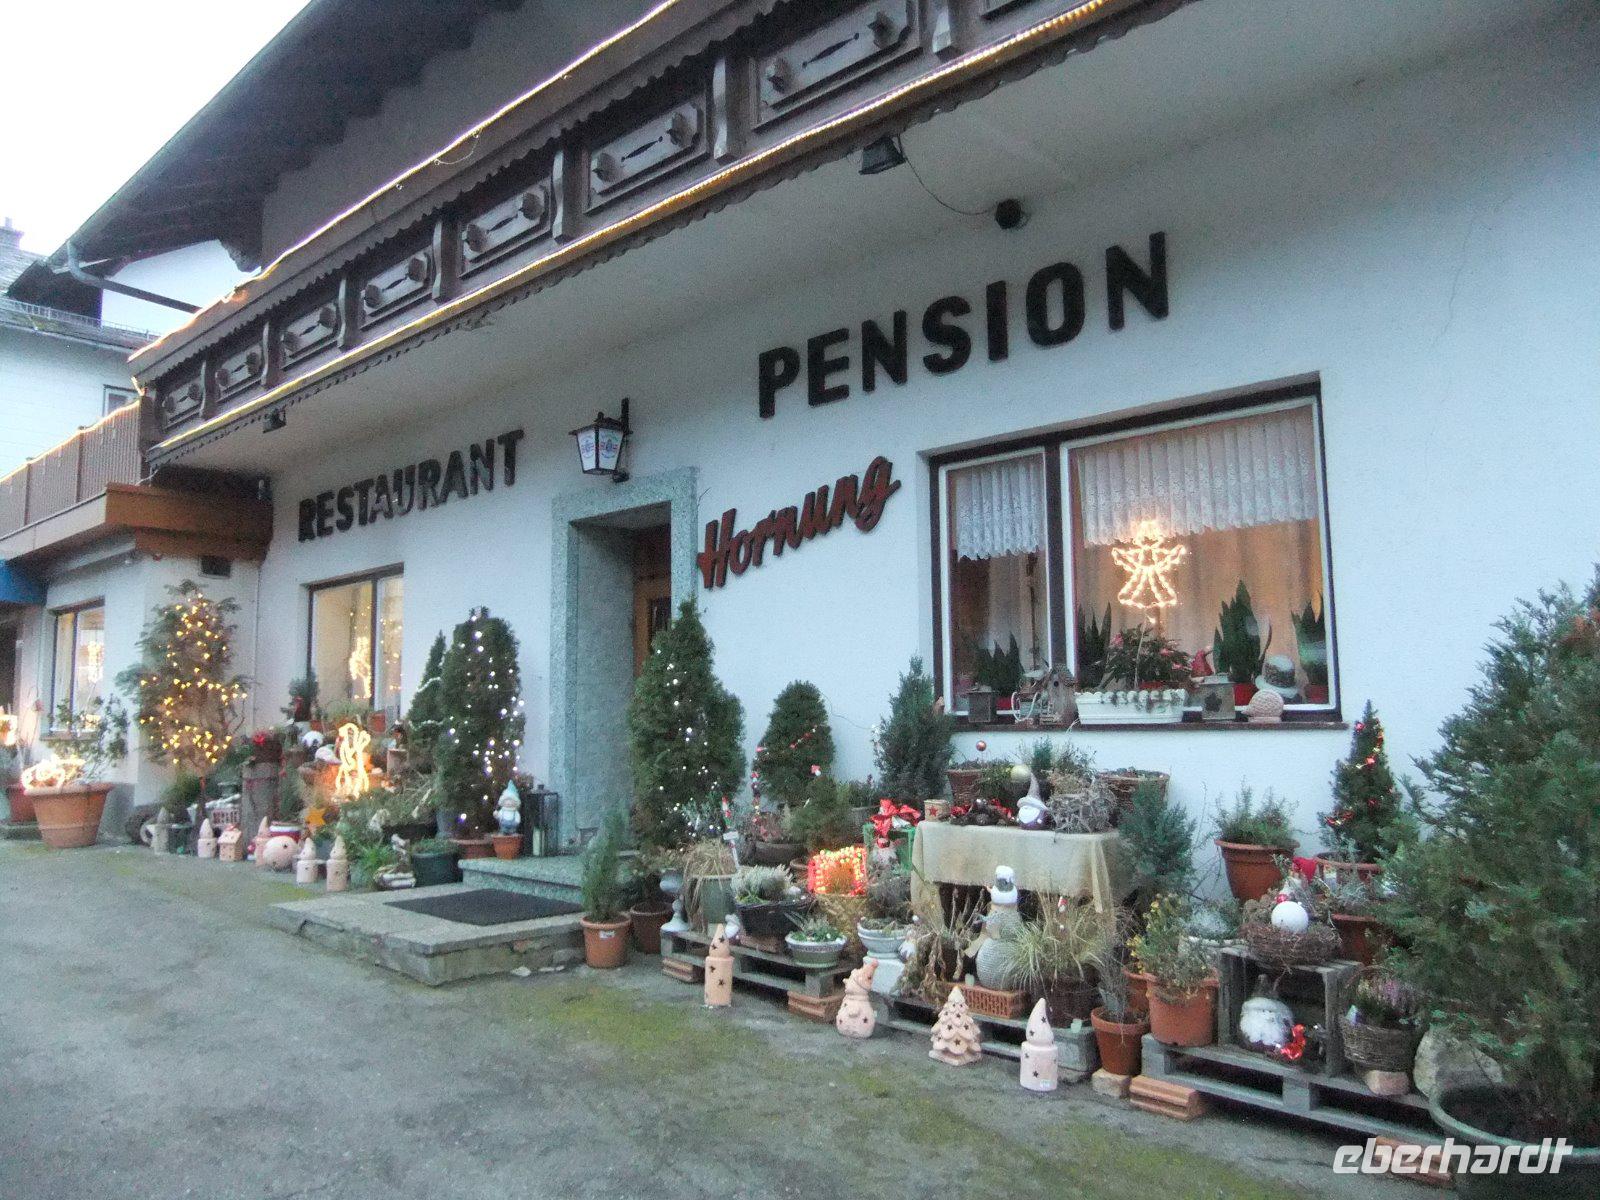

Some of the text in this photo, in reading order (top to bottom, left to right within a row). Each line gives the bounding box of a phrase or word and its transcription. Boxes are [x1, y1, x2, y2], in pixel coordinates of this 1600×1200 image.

[759, 231, 1169, 419] PENSION
[298, 429, 525, 542] RESTAURANT
[697, 456, 902, 589] Hornung
